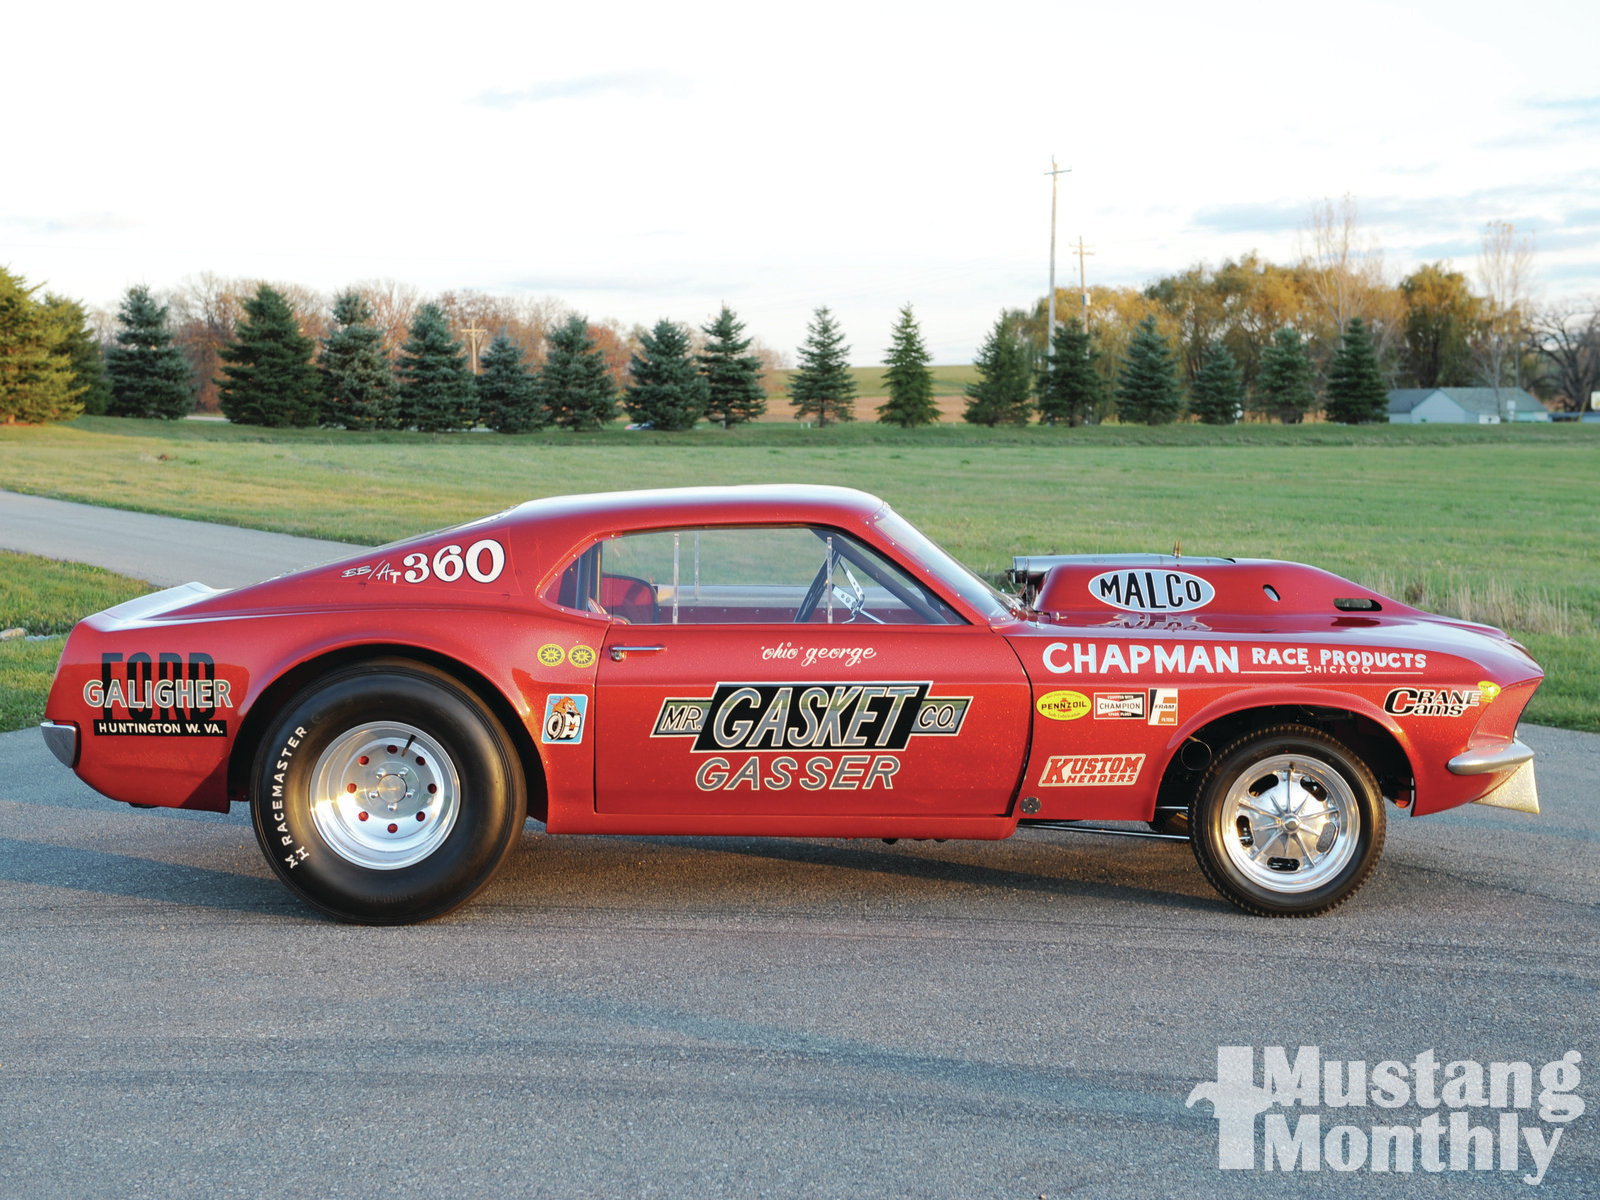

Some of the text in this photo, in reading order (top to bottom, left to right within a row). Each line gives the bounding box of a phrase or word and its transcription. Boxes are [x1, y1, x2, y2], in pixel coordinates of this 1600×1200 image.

[402, 538, 506, 584] 360
[1099, 572, 1202, 609] MALCO
[801, 647, 877, 667] george
[1042, 642, 1427, 674] CHAPMAN RACE PRODUCTS
[1305, 665, 1371, 674] CHICAGO
[83, 679, 233, 708] GALIGHER
[101, 652, 215, 721] FORD
[1041, 701, 1087, 710] PENNZOIL
[1099, 702, 1141, 710] CHAMPION
[1383, 687, 1482, 717] CRANE
[98, 722, 223, 734] HUNTINGTON W. VA.
[660, 687, 955, 748] MR. GASKET CO.
[695, 755, 901, 791] GASSER
[1042, 756, 1142, 784] KUSTOM
[1066, 774, 1136, 783] HEADERS
[272, 726, 307, 846] RACEMASTER
